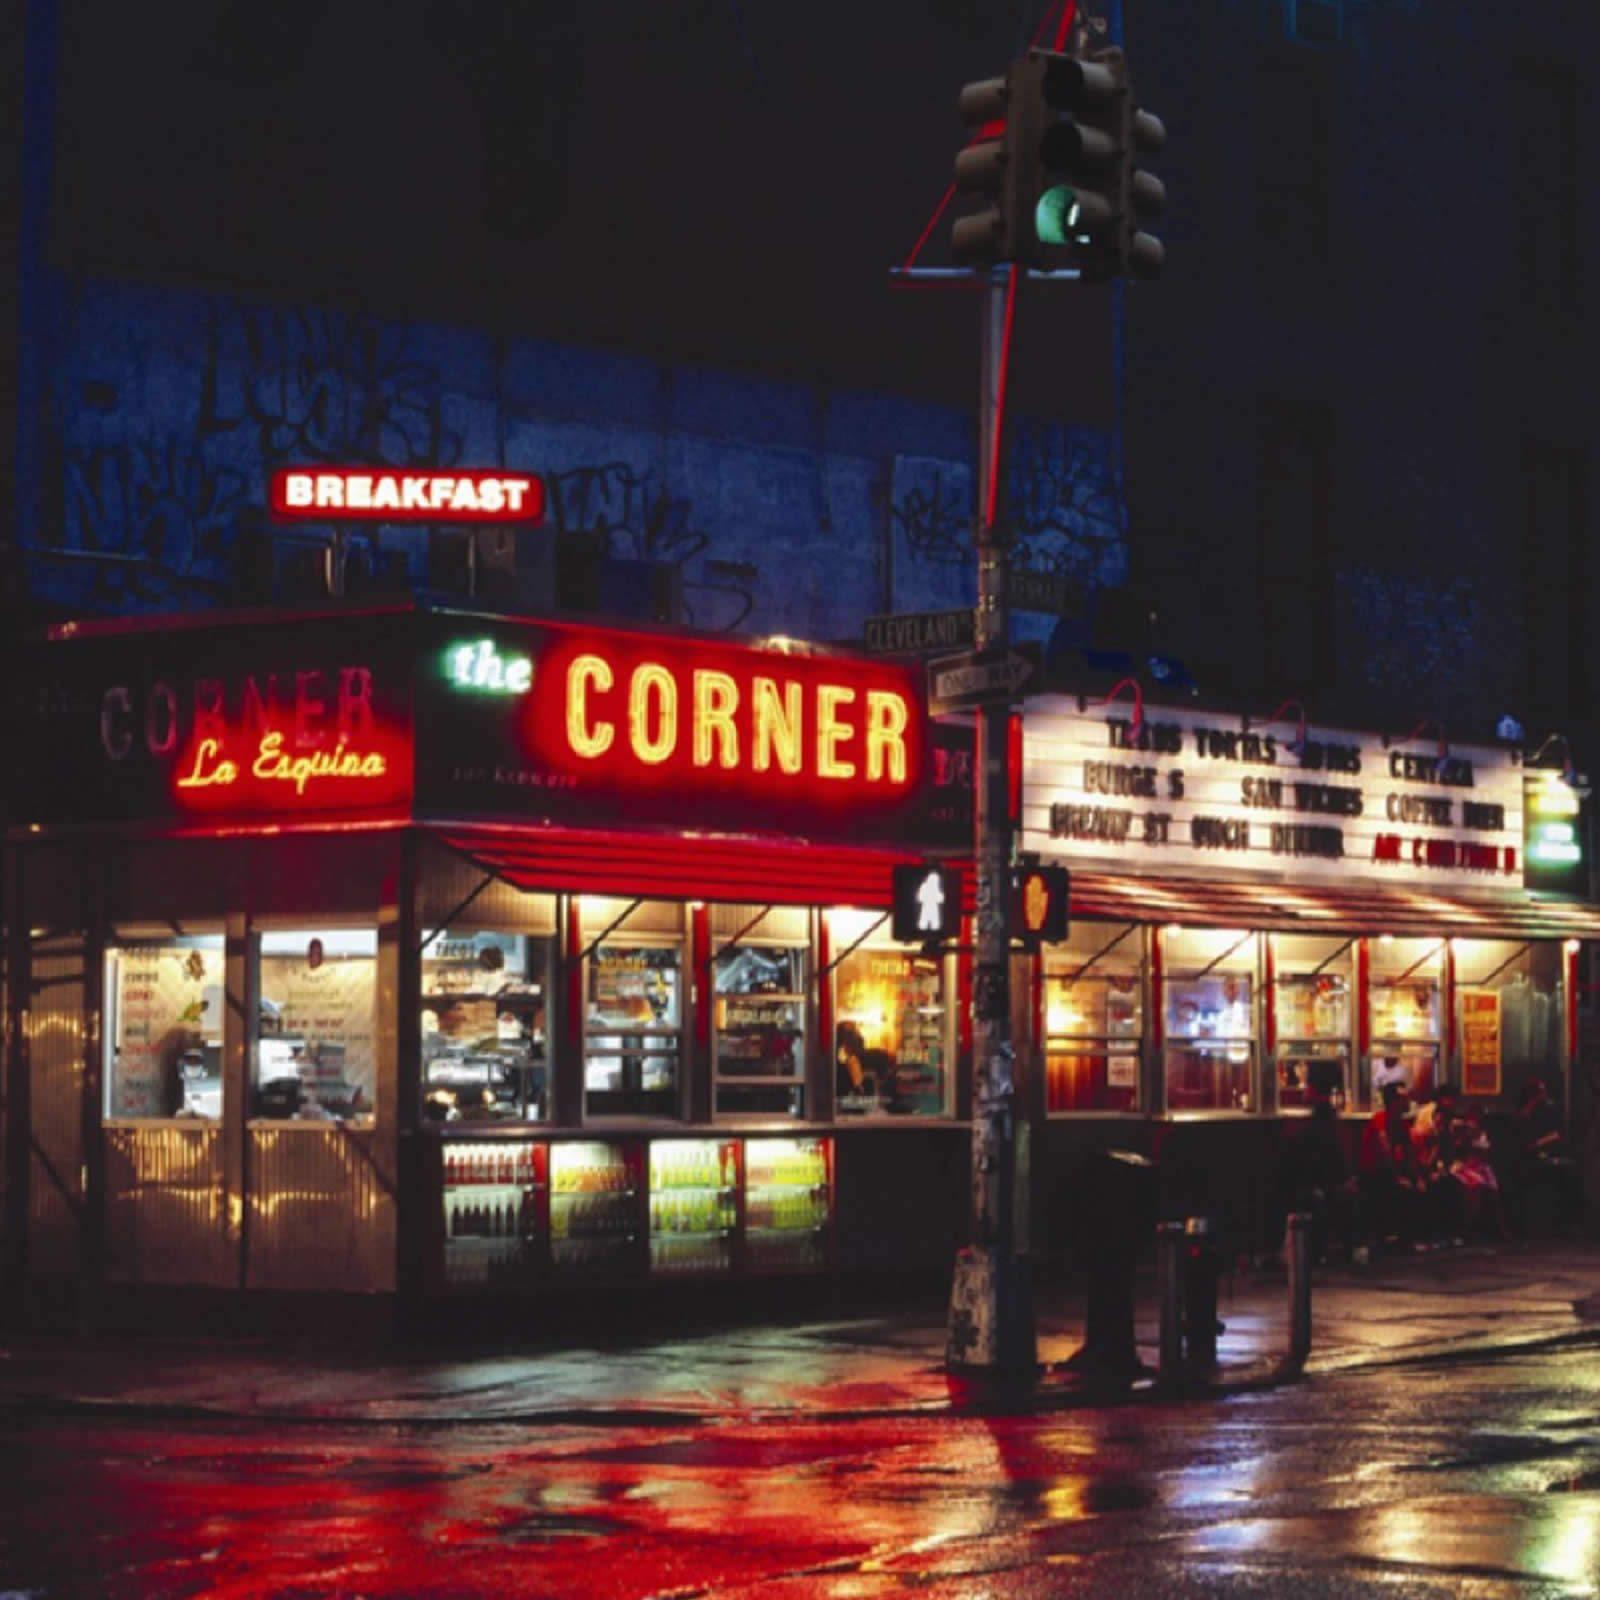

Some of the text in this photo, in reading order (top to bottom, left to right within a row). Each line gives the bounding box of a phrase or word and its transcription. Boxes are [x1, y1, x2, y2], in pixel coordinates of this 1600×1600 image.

[285, 475, 530, 511] BREAKFAST
[867, 617, 958, 650] CLEVELAND
[101, 667, 374, 760] CORNER
[452, 639, 909, 783] the CORNER
[178, 741, 236, 788] La
[252, 732, 387, 794] Esquina
